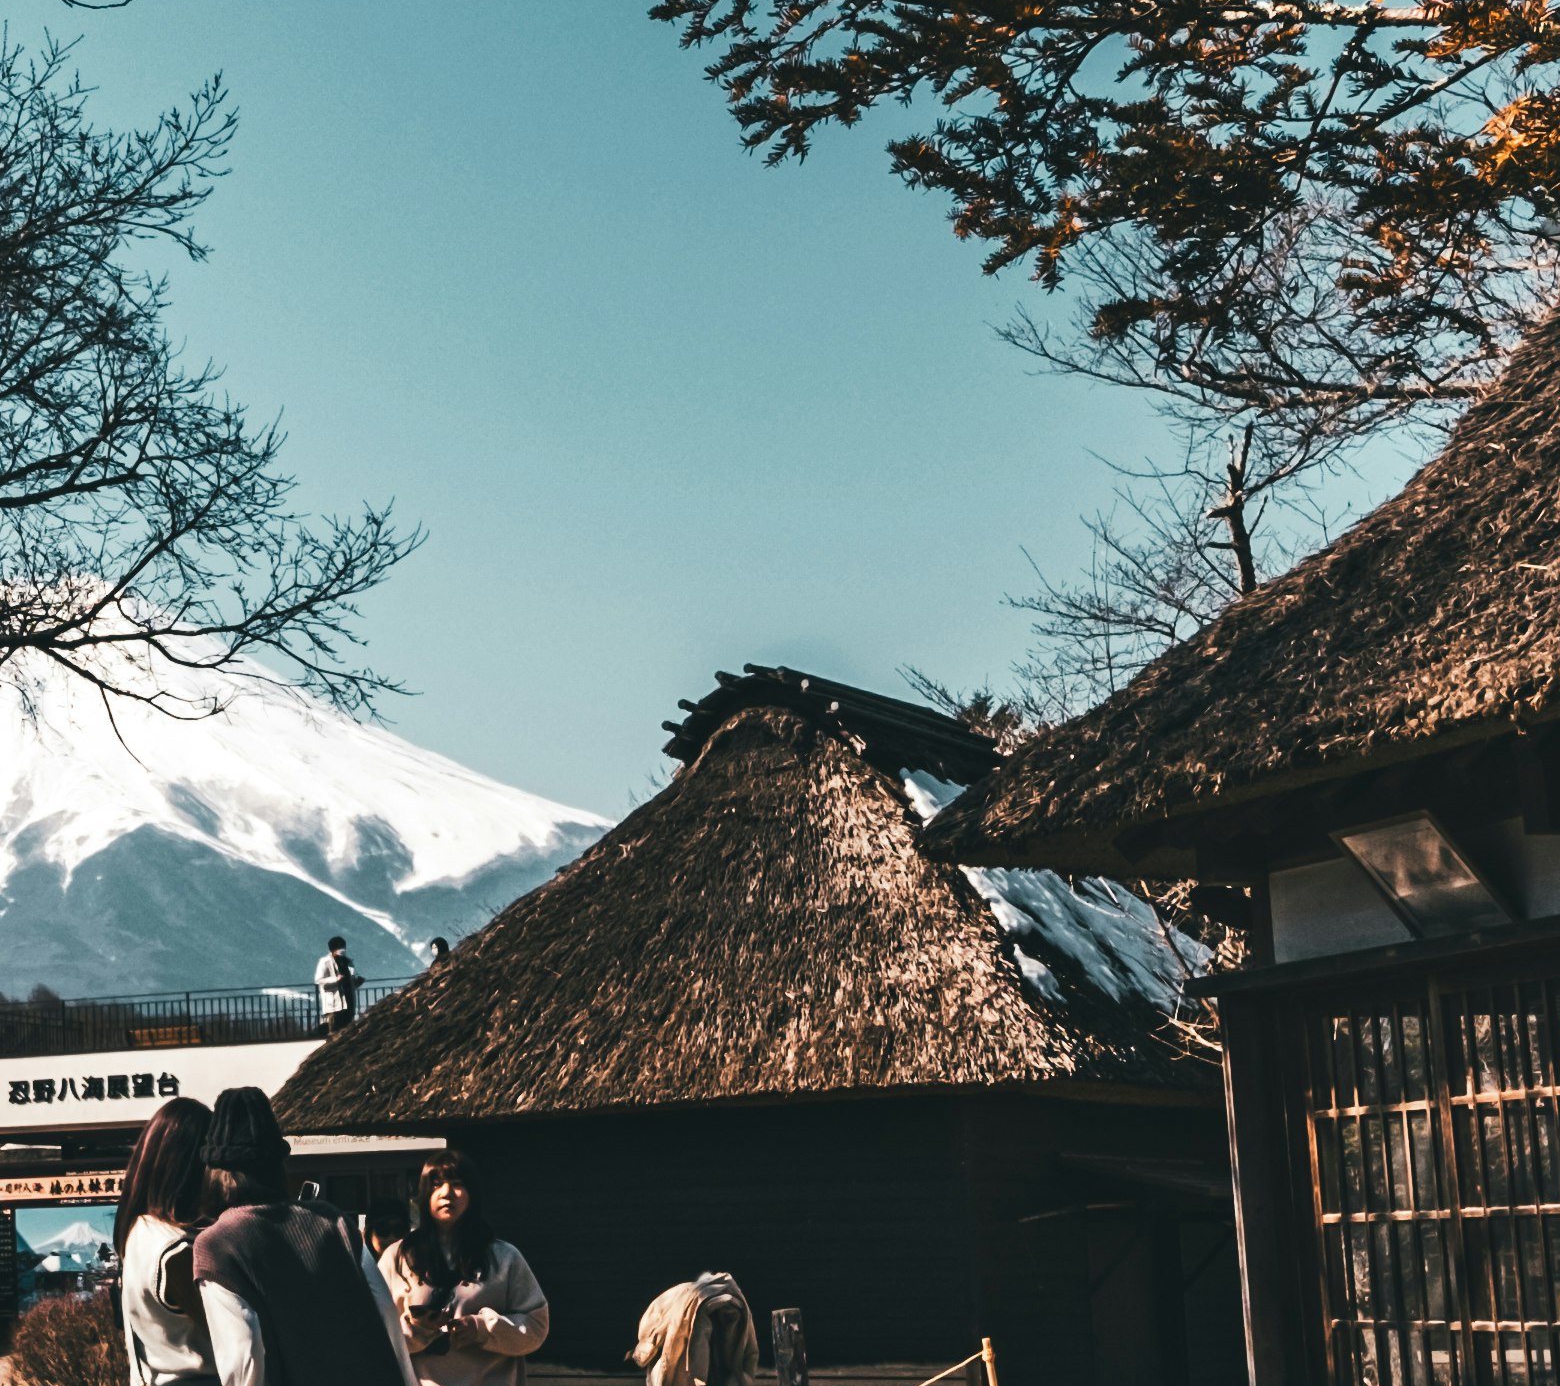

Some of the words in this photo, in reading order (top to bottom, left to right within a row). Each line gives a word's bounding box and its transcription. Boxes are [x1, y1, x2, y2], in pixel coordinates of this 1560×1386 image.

[8, 1071, 180, 1104] 忍野八海展望台
